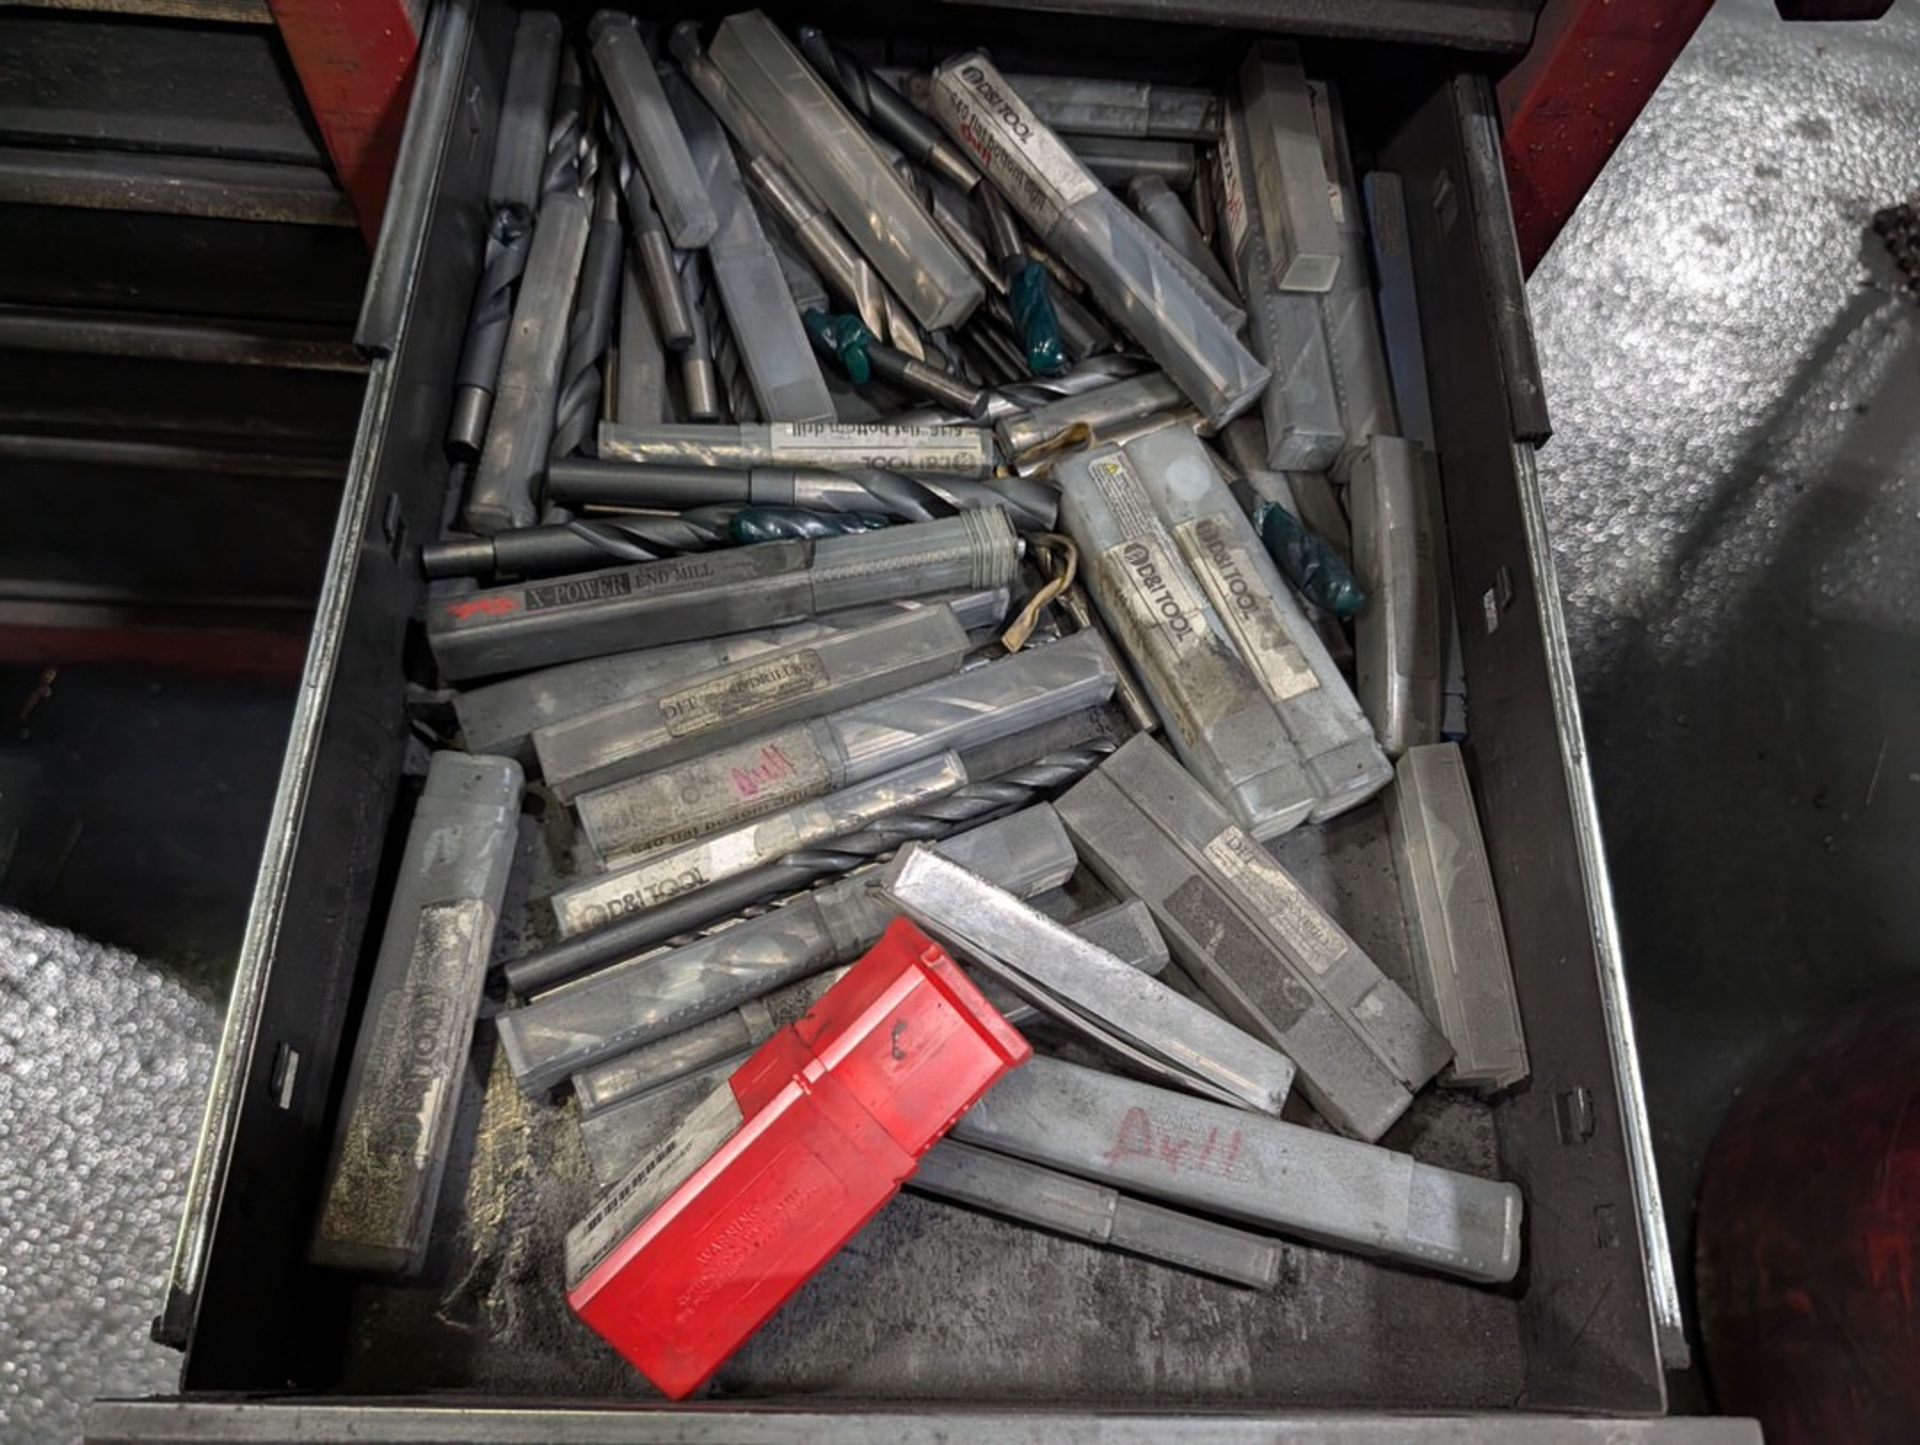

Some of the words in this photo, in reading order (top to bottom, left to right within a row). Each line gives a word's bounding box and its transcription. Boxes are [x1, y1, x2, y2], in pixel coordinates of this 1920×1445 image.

[997, 102, 1034, 145] TOOL
[529, 575, 629, 610] X-POWER
[634, 568, 670, 590] END
[674, 562, 714, 584] MILL
[1136, 563, 1167, 594] D&I
[1156, 590, 1193, 642] TOOL
[1206, 540, 1235, 571] D&I
[1224, 567, 1260, 621] TOOL
[607, 889, 647, 918] D&I
[643, 866, 711, 902] TOOL
